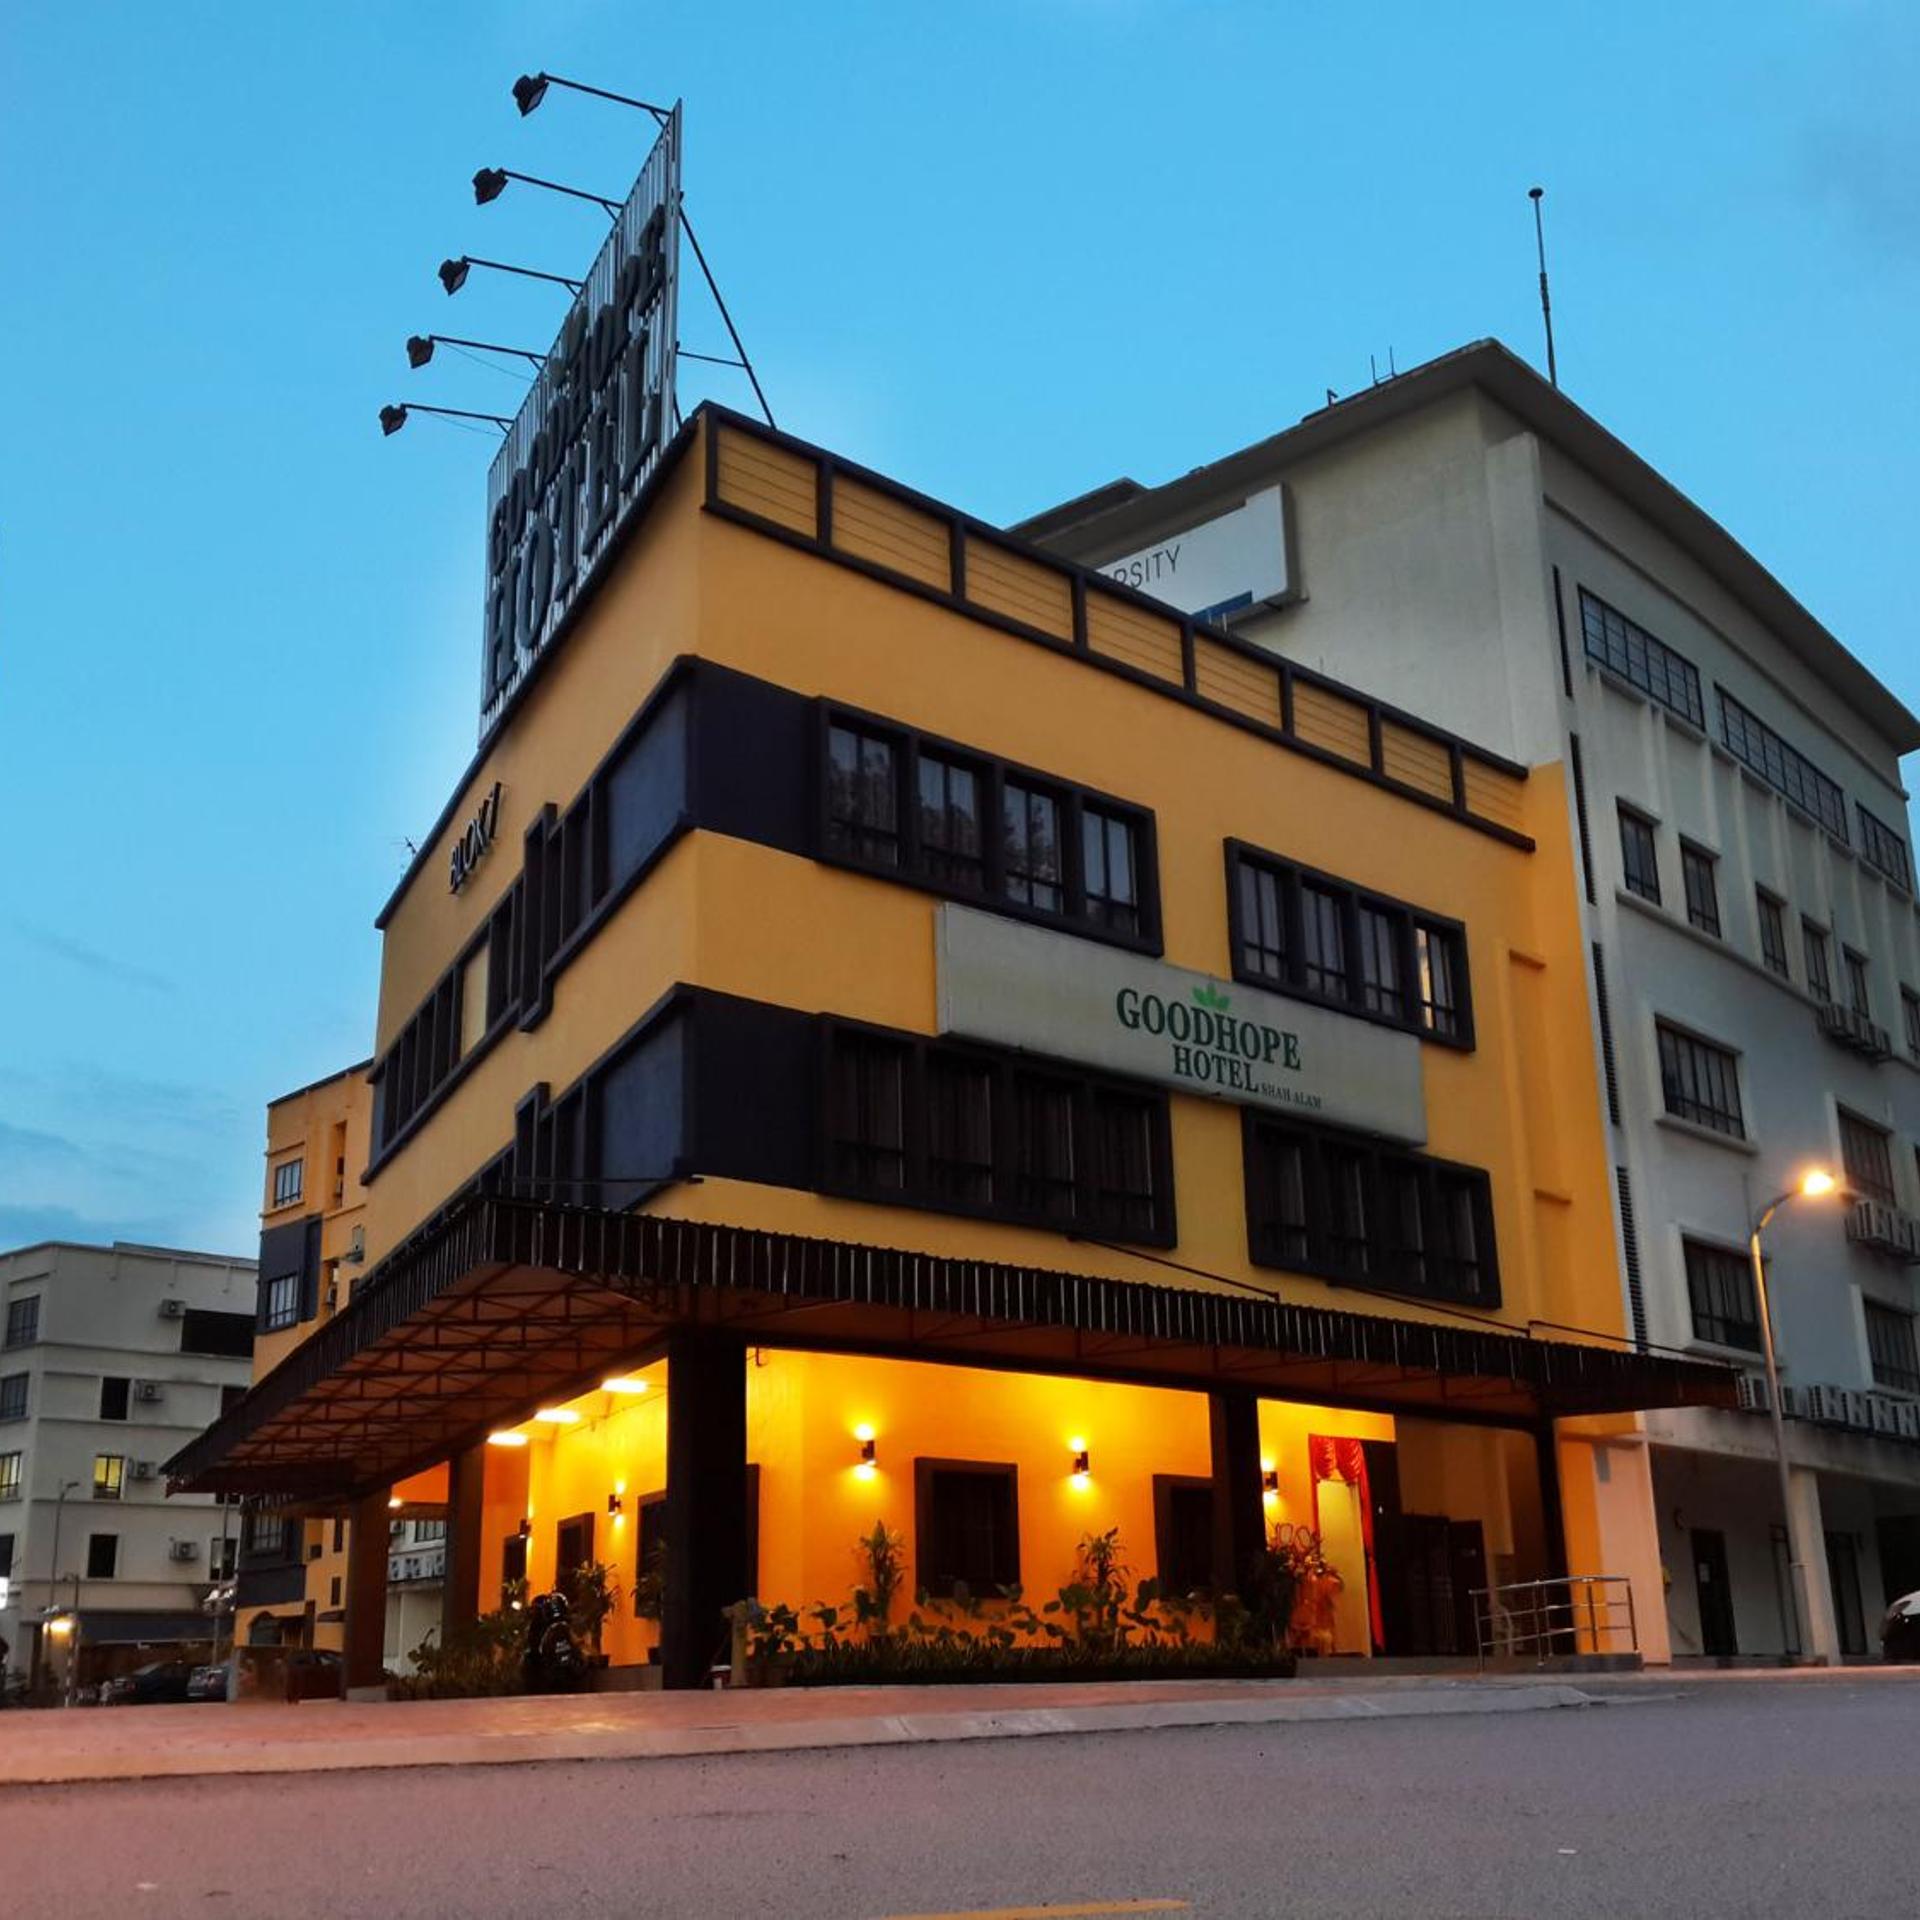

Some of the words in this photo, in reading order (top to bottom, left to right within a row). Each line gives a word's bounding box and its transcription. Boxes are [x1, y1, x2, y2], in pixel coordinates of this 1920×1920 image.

[481, 329, 662, 716] HOTEL
[1116, 987, 1302, 1072] GOODHOPE
[1172, 1043, 1260, 1093] HOTEL
